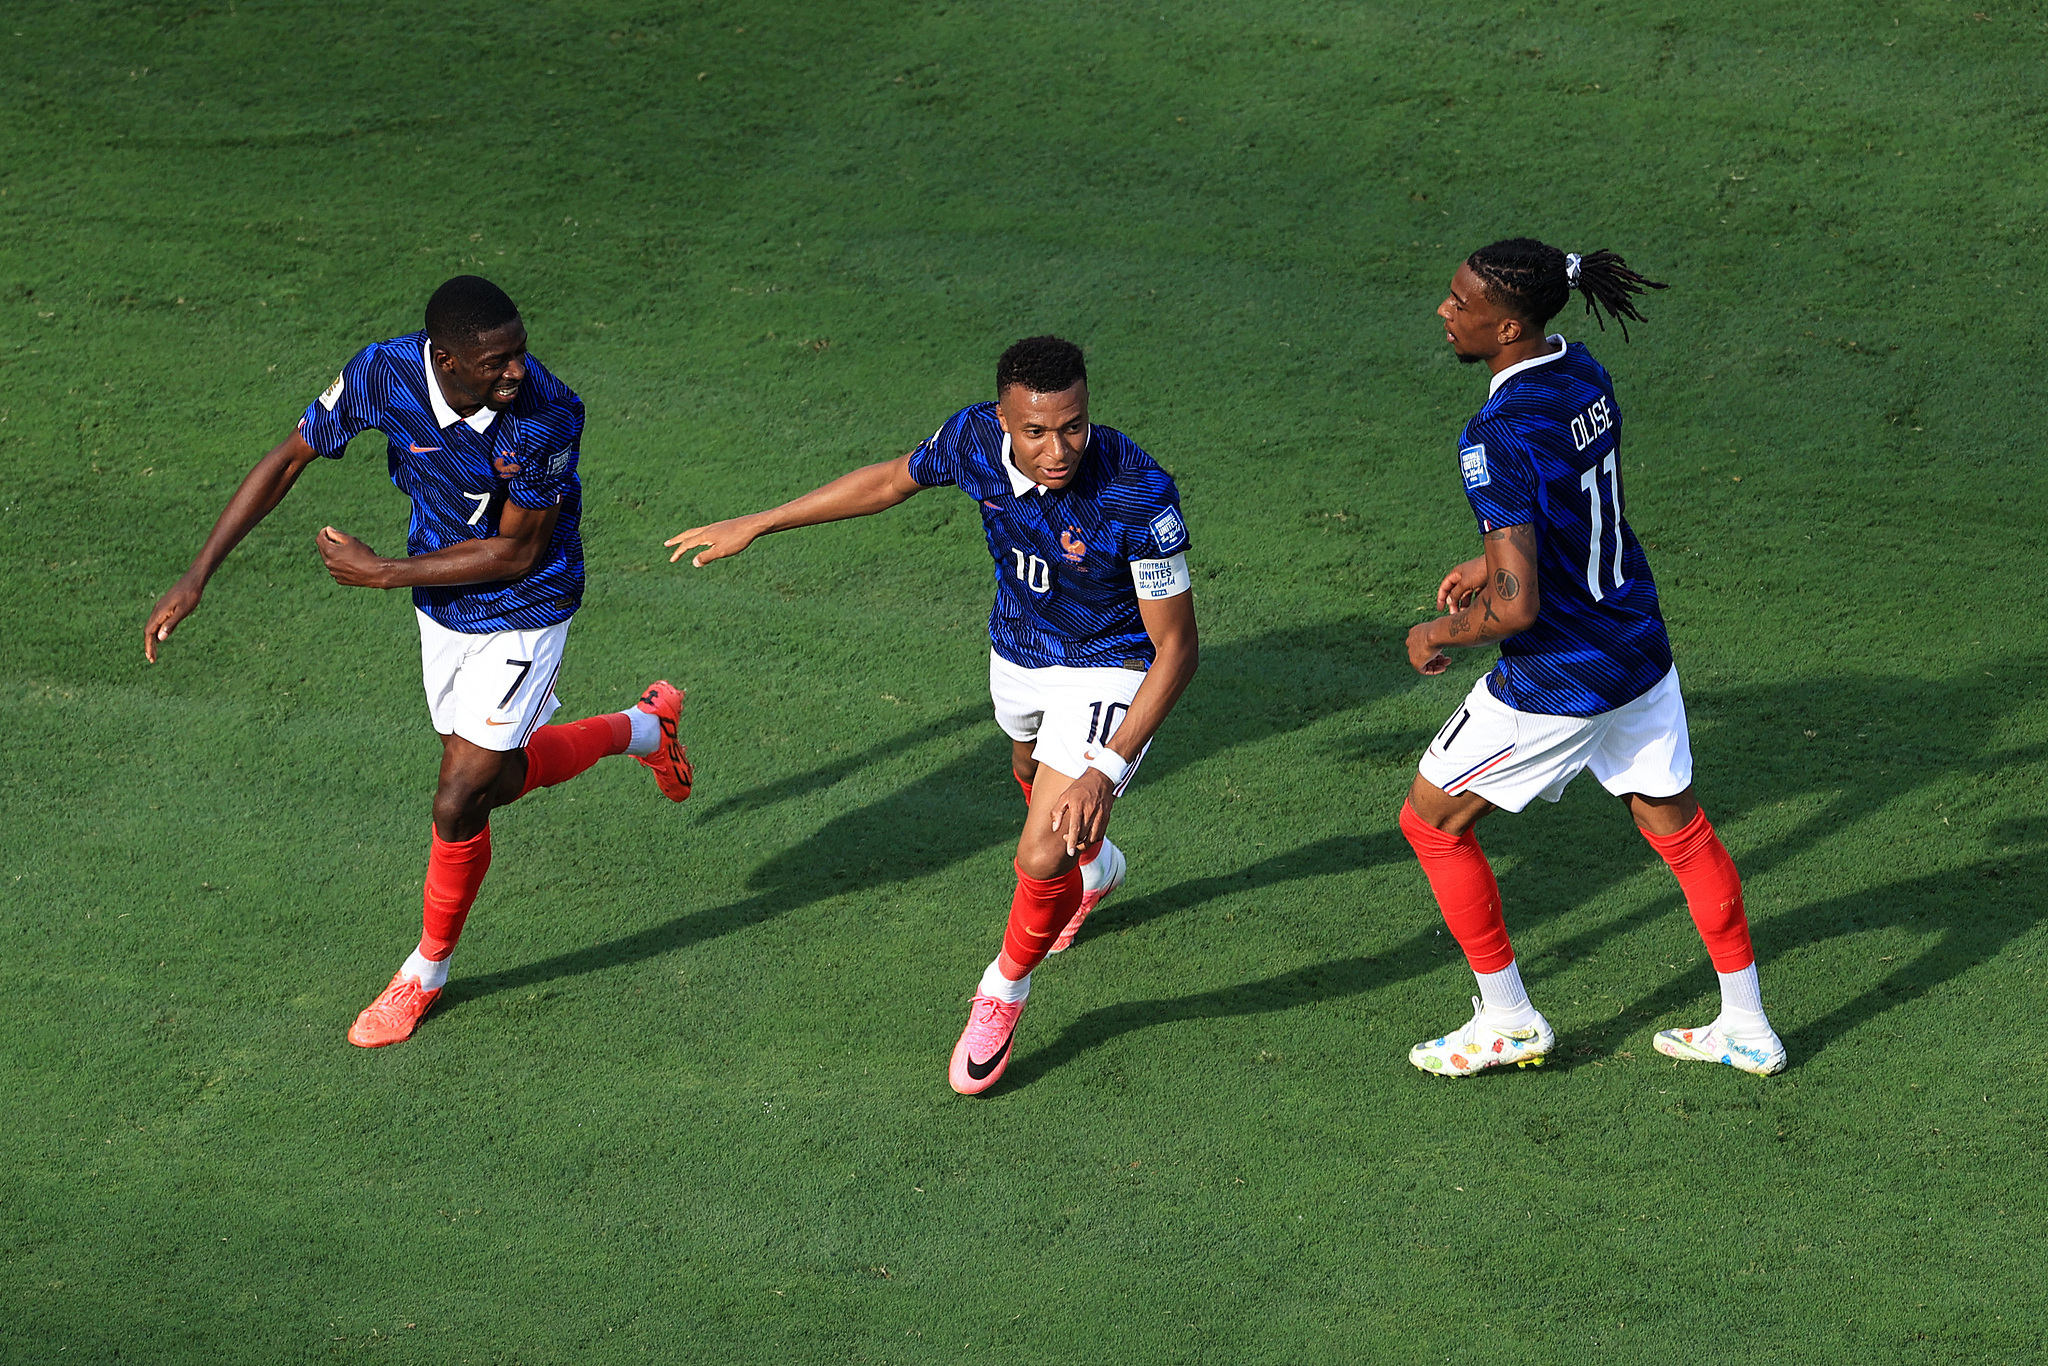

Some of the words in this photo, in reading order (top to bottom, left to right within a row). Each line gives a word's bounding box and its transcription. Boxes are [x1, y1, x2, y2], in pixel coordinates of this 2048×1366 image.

[1571, 396, 1612, 451] OLISE
[463, 491, 490, 525] 7
[1581, 448, 1625, 602] 11
[1012, 547, 1050, 593] 10
[1139, 561, 1171, 571] FOOTBALL
[1139, 568, 1172, 580] UNITES
[1152, 576, 1176, 589] World
[497, 659, 533, 709] 7
[1438, 702, 1471, 752] 11
